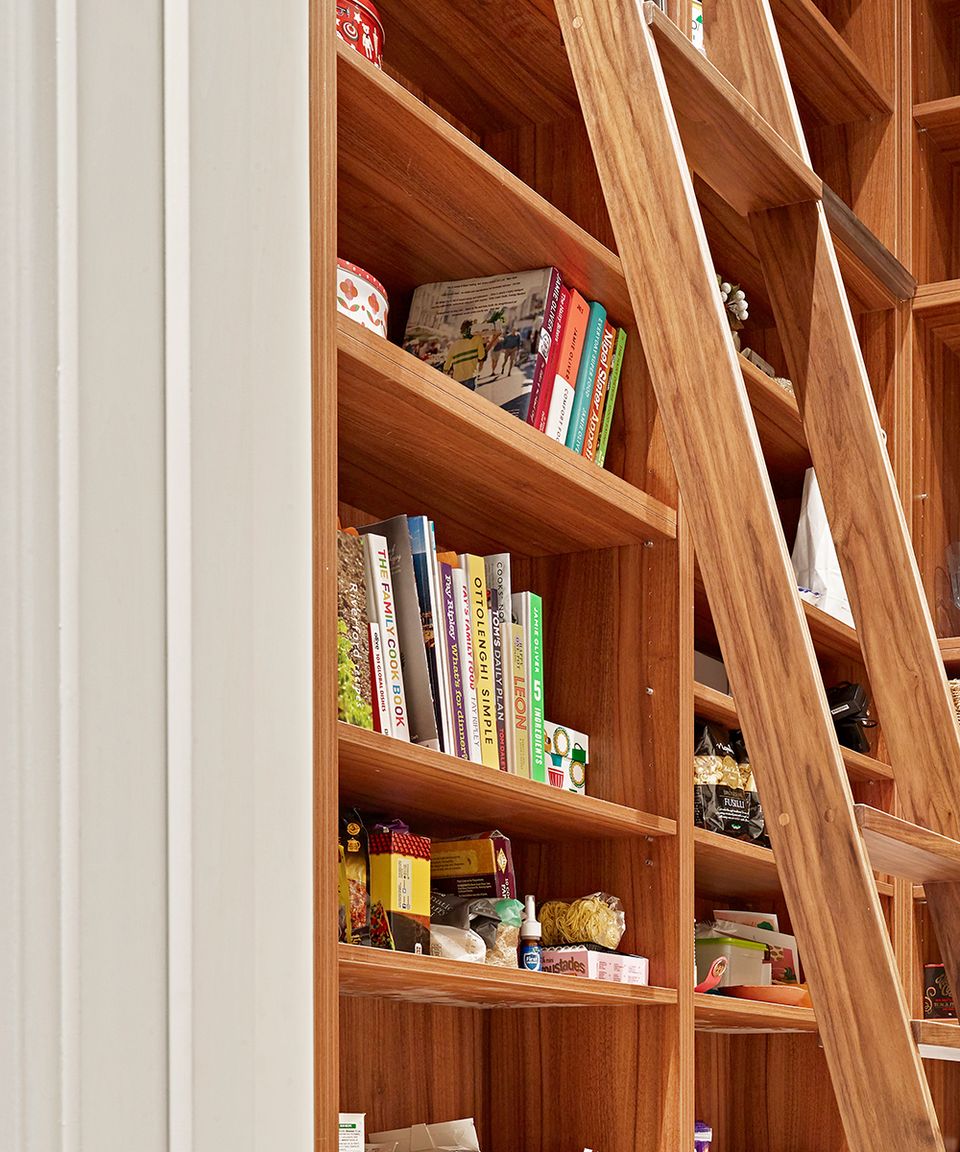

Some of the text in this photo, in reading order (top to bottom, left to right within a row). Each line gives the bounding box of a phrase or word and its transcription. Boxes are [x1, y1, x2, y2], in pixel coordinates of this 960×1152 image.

[548, 300, 558, 332] OLIVER
[592, 318, 602, 354] EVERYDAY
[566, 351, 574, 380] OLIVER
[585, 377, 593, 398] FOOD
[585, 329, 614, 460] Nigel Slater Appeti
[560, 388, 568, 426] COMFORT
[443, 573, 452, 599] Fay
[350, 583, 360, 658] Riverford
[377, 549, 405, 727] THE FAMILY COOK BOOK
[447, 600, 456, 640] Ripley
[492, 610, 501, 647] TOM'S
[452, 643, 460, 688] What's
[474, 577, 493, 745] OTTOLENGHI SIMPLE
[493, 649, 502, 684] DAILY
[454, 689, 463, 708] for
[496, 687, 504, 721] PLAN
[514, 676, 527, 731] LEON
[533, 679, 543, 765] 5 INGREDIENTS
[499, 746, 507, 771] DALEY
[724, 798, 744, 808] FUSILLI
